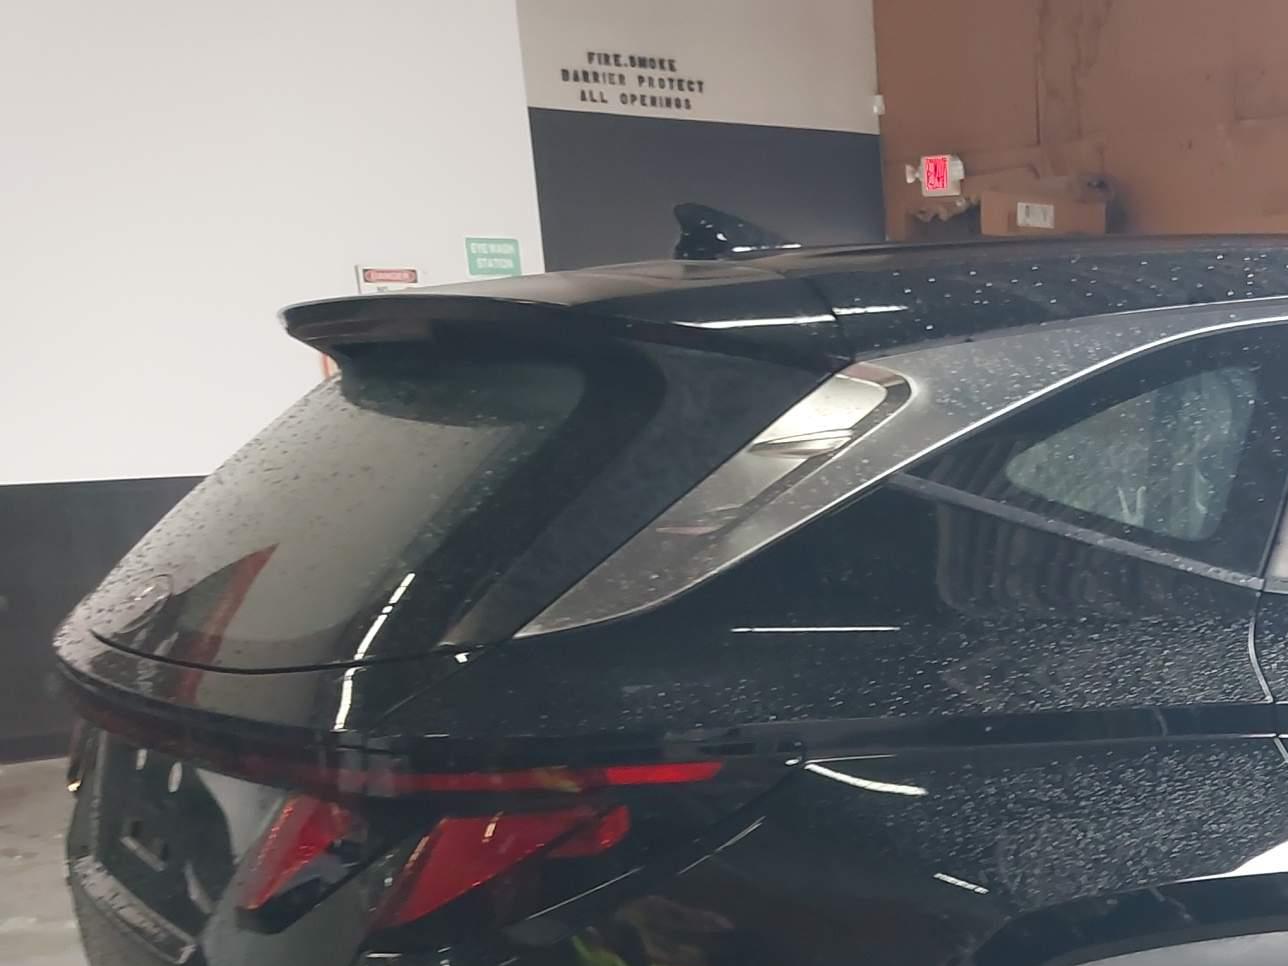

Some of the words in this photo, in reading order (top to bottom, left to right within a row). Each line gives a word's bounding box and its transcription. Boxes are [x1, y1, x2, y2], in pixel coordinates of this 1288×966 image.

[561, 69, 626, 86] BARRIER
[638, 75, 704, 93] PROTECT
[580, 89, 608, 104] ALL
[620, 93, 692, 110] OPENINGS
